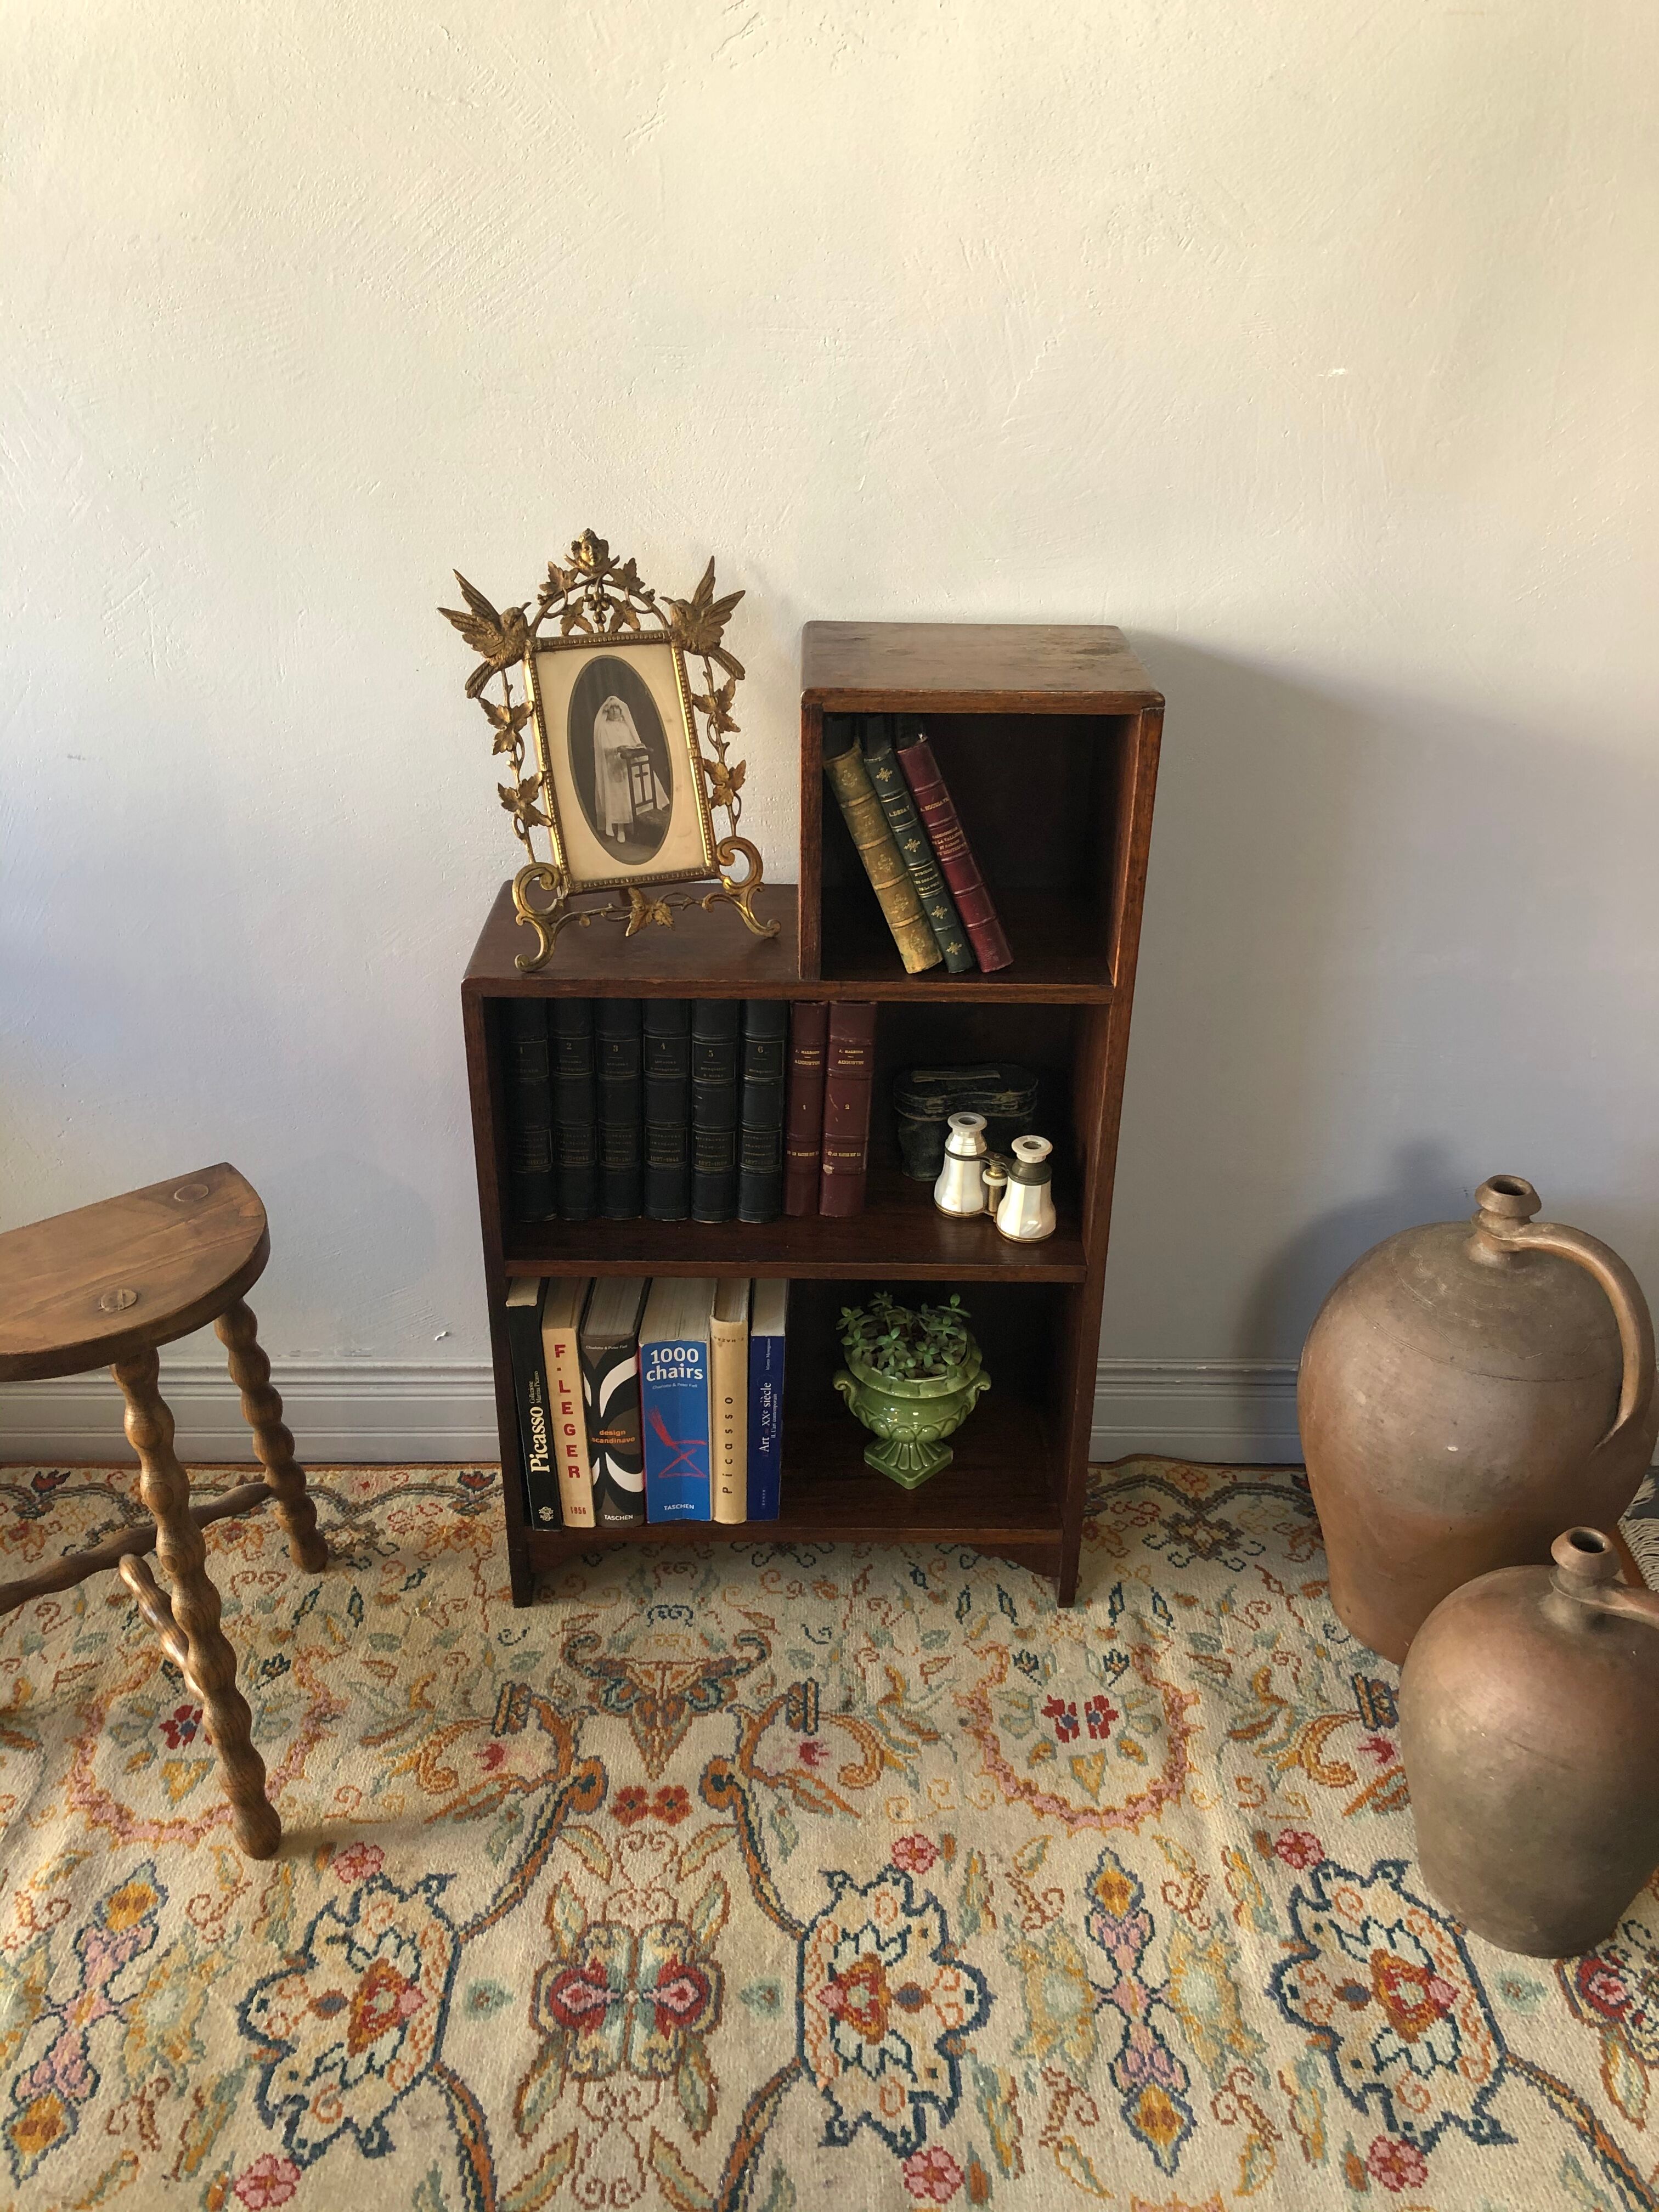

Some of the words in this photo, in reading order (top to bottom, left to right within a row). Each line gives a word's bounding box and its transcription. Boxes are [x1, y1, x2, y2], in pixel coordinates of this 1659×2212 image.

[708, 1049, 714, 1058] 5
[757, 1045, 764, 1053] 6
[651, 1347, 699, 1364] 1000
[646, 1363, 703, 1381] chairs
[760, 1383, 771, 1407] siècle
[529, 1407, 550, 1473] Picasso
[723, 1397, 733, 1493] Picasso
